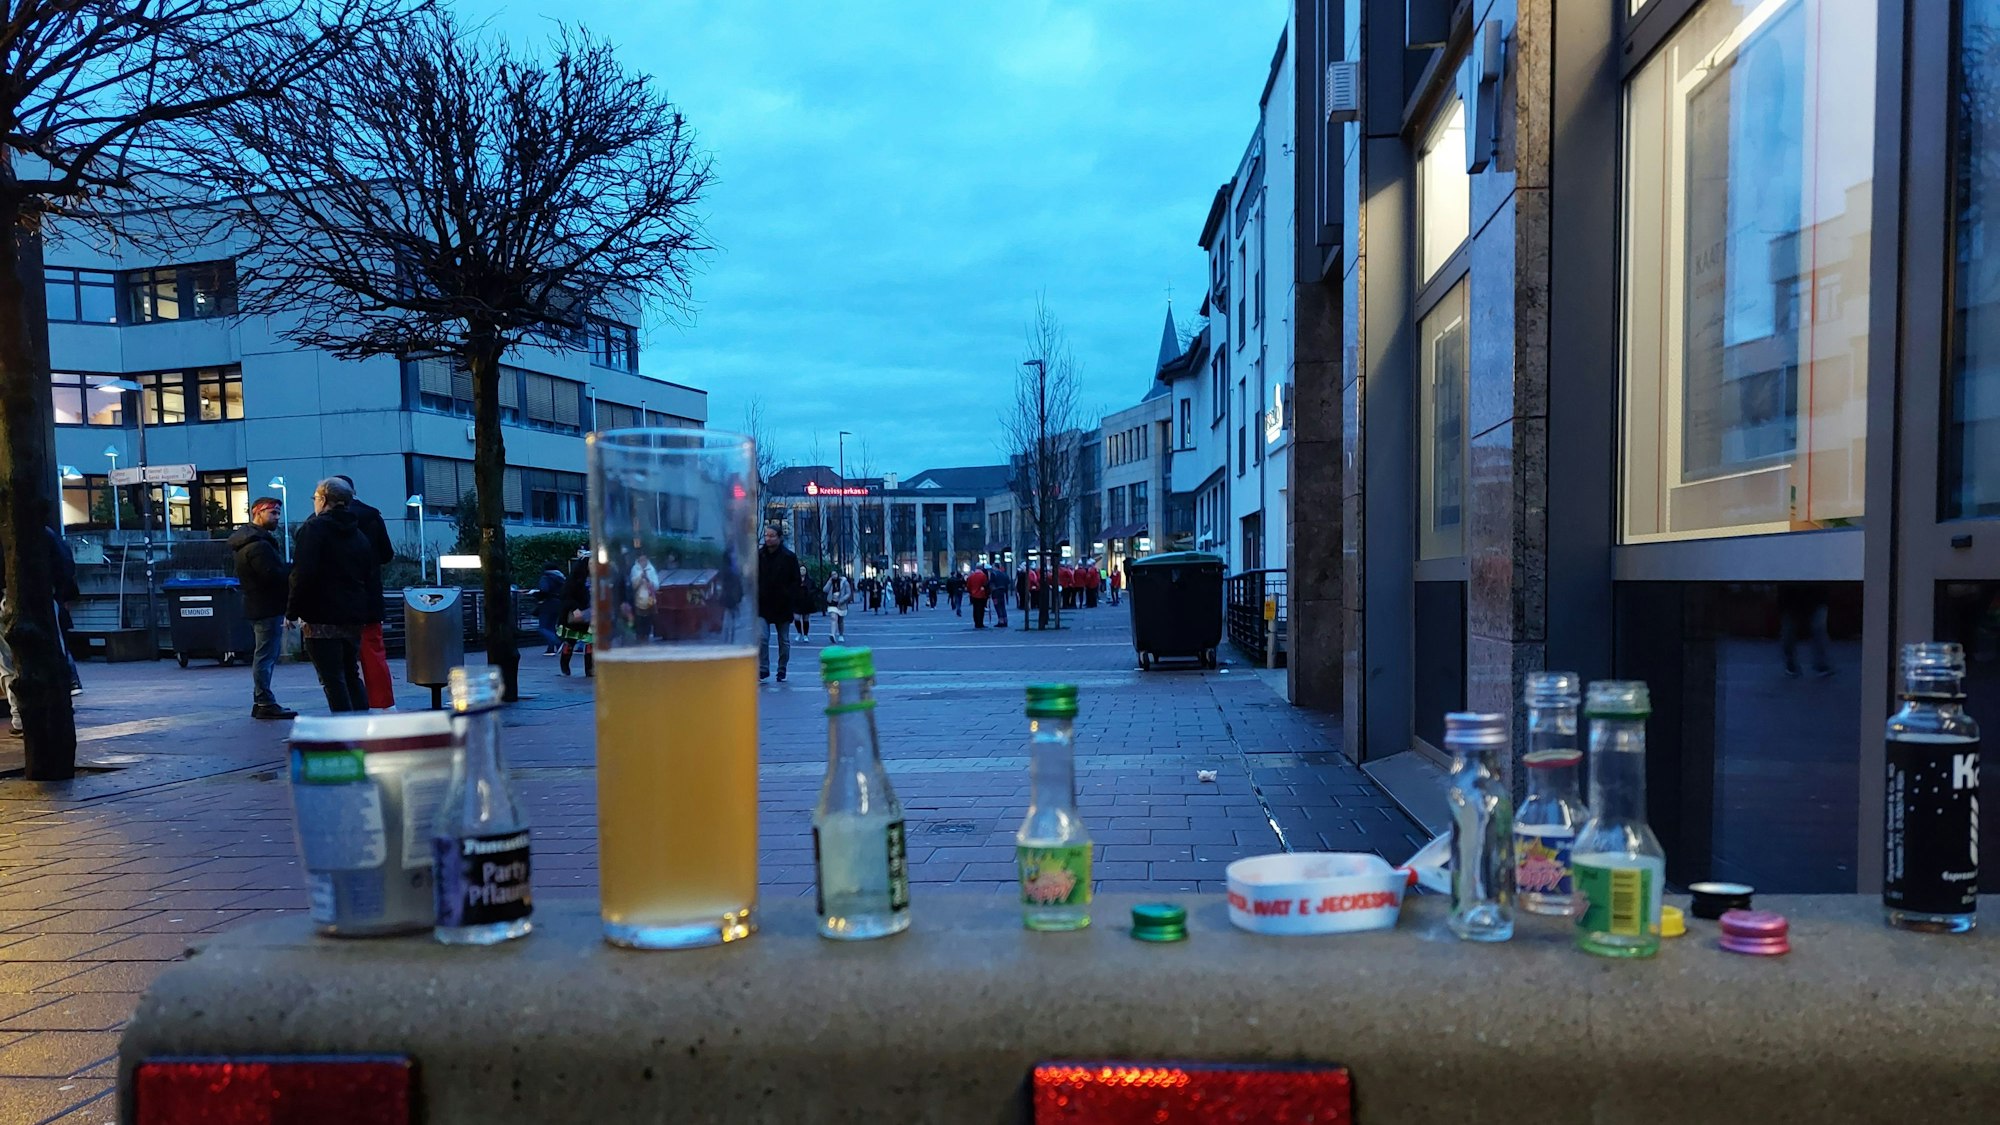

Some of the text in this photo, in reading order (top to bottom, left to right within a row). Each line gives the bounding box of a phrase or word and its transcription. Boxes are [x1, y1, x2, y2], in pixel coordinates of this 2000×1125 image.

[182, 608, 210, 616] REMONDIS
[482, 861, 527, 885] Party
[1253, 900, 1292, 916] WAT
[1298, 899, 1310, 915] E
